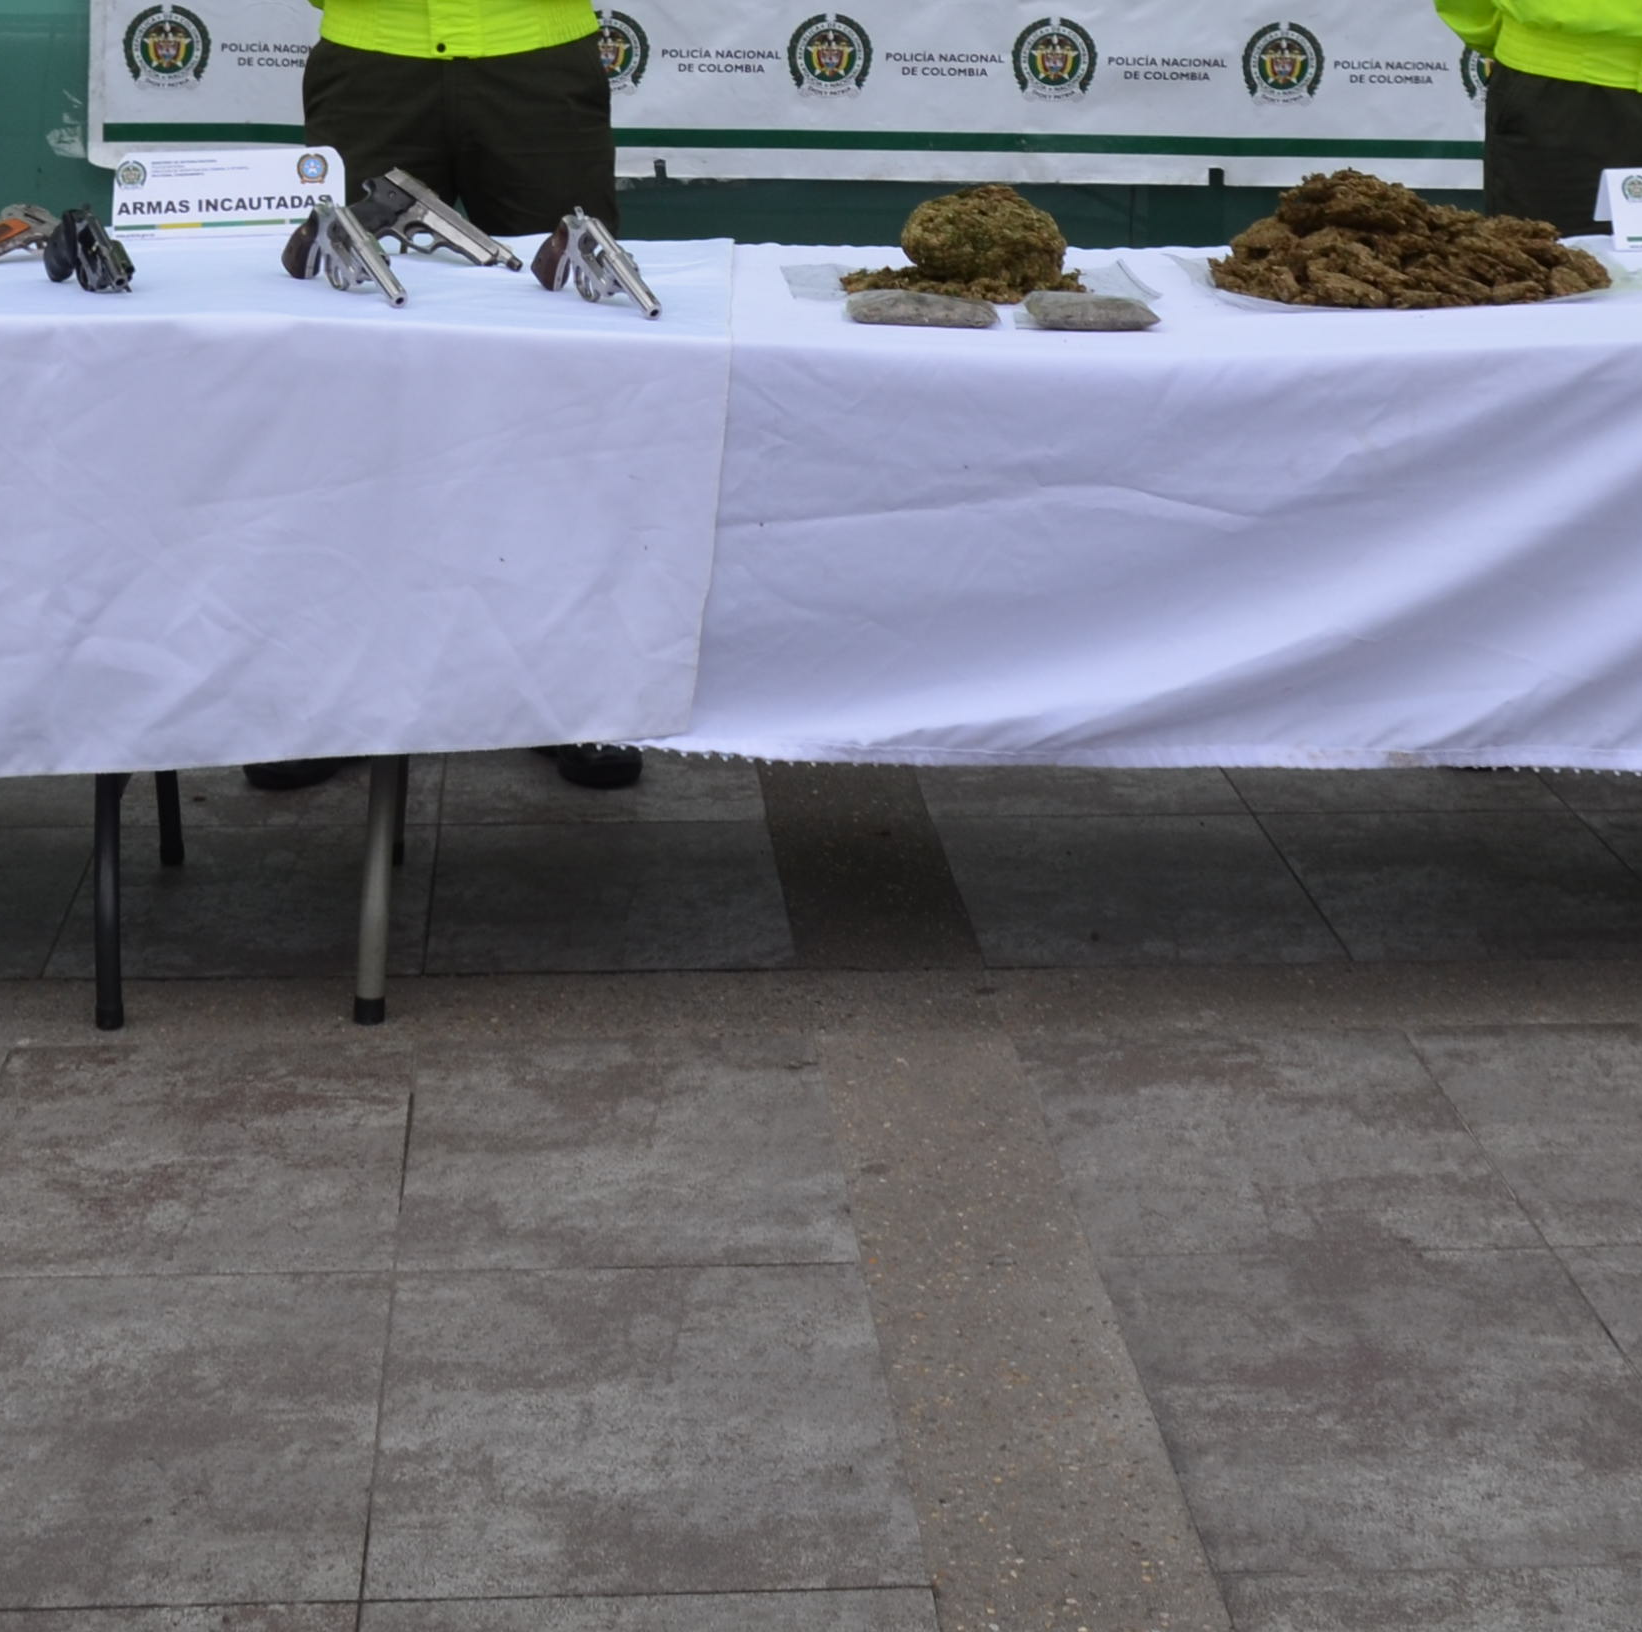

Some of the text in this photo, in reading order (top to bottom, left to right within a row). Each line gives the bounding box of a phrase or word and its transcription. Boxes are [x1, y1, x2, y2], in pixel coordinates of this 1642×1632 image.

[220, 42, 312, 55] POLICÍA NACIO
[661, 47, 782, 60] POLICÍA NACIONAL
[237, 57, 305, 68] DE COLOMB
[885, 50, 1005, 64] POLICÍA NACIONAL
[1107, 55, 1228, 69] POLICÍA NACIONAL
[677, 62, 765, 74] DE COLOMBIA
[901, 66, 989, 77] DE COLOMBIA
[1333, 59, 1450, 72] POLICÍA NACIONAL
[1123, 70, 1211, 81] DE COLOMBIA
[1349, 73, 1434, 85] DE COLOMBIA
[117, 198, 191, 217] ARMAS
